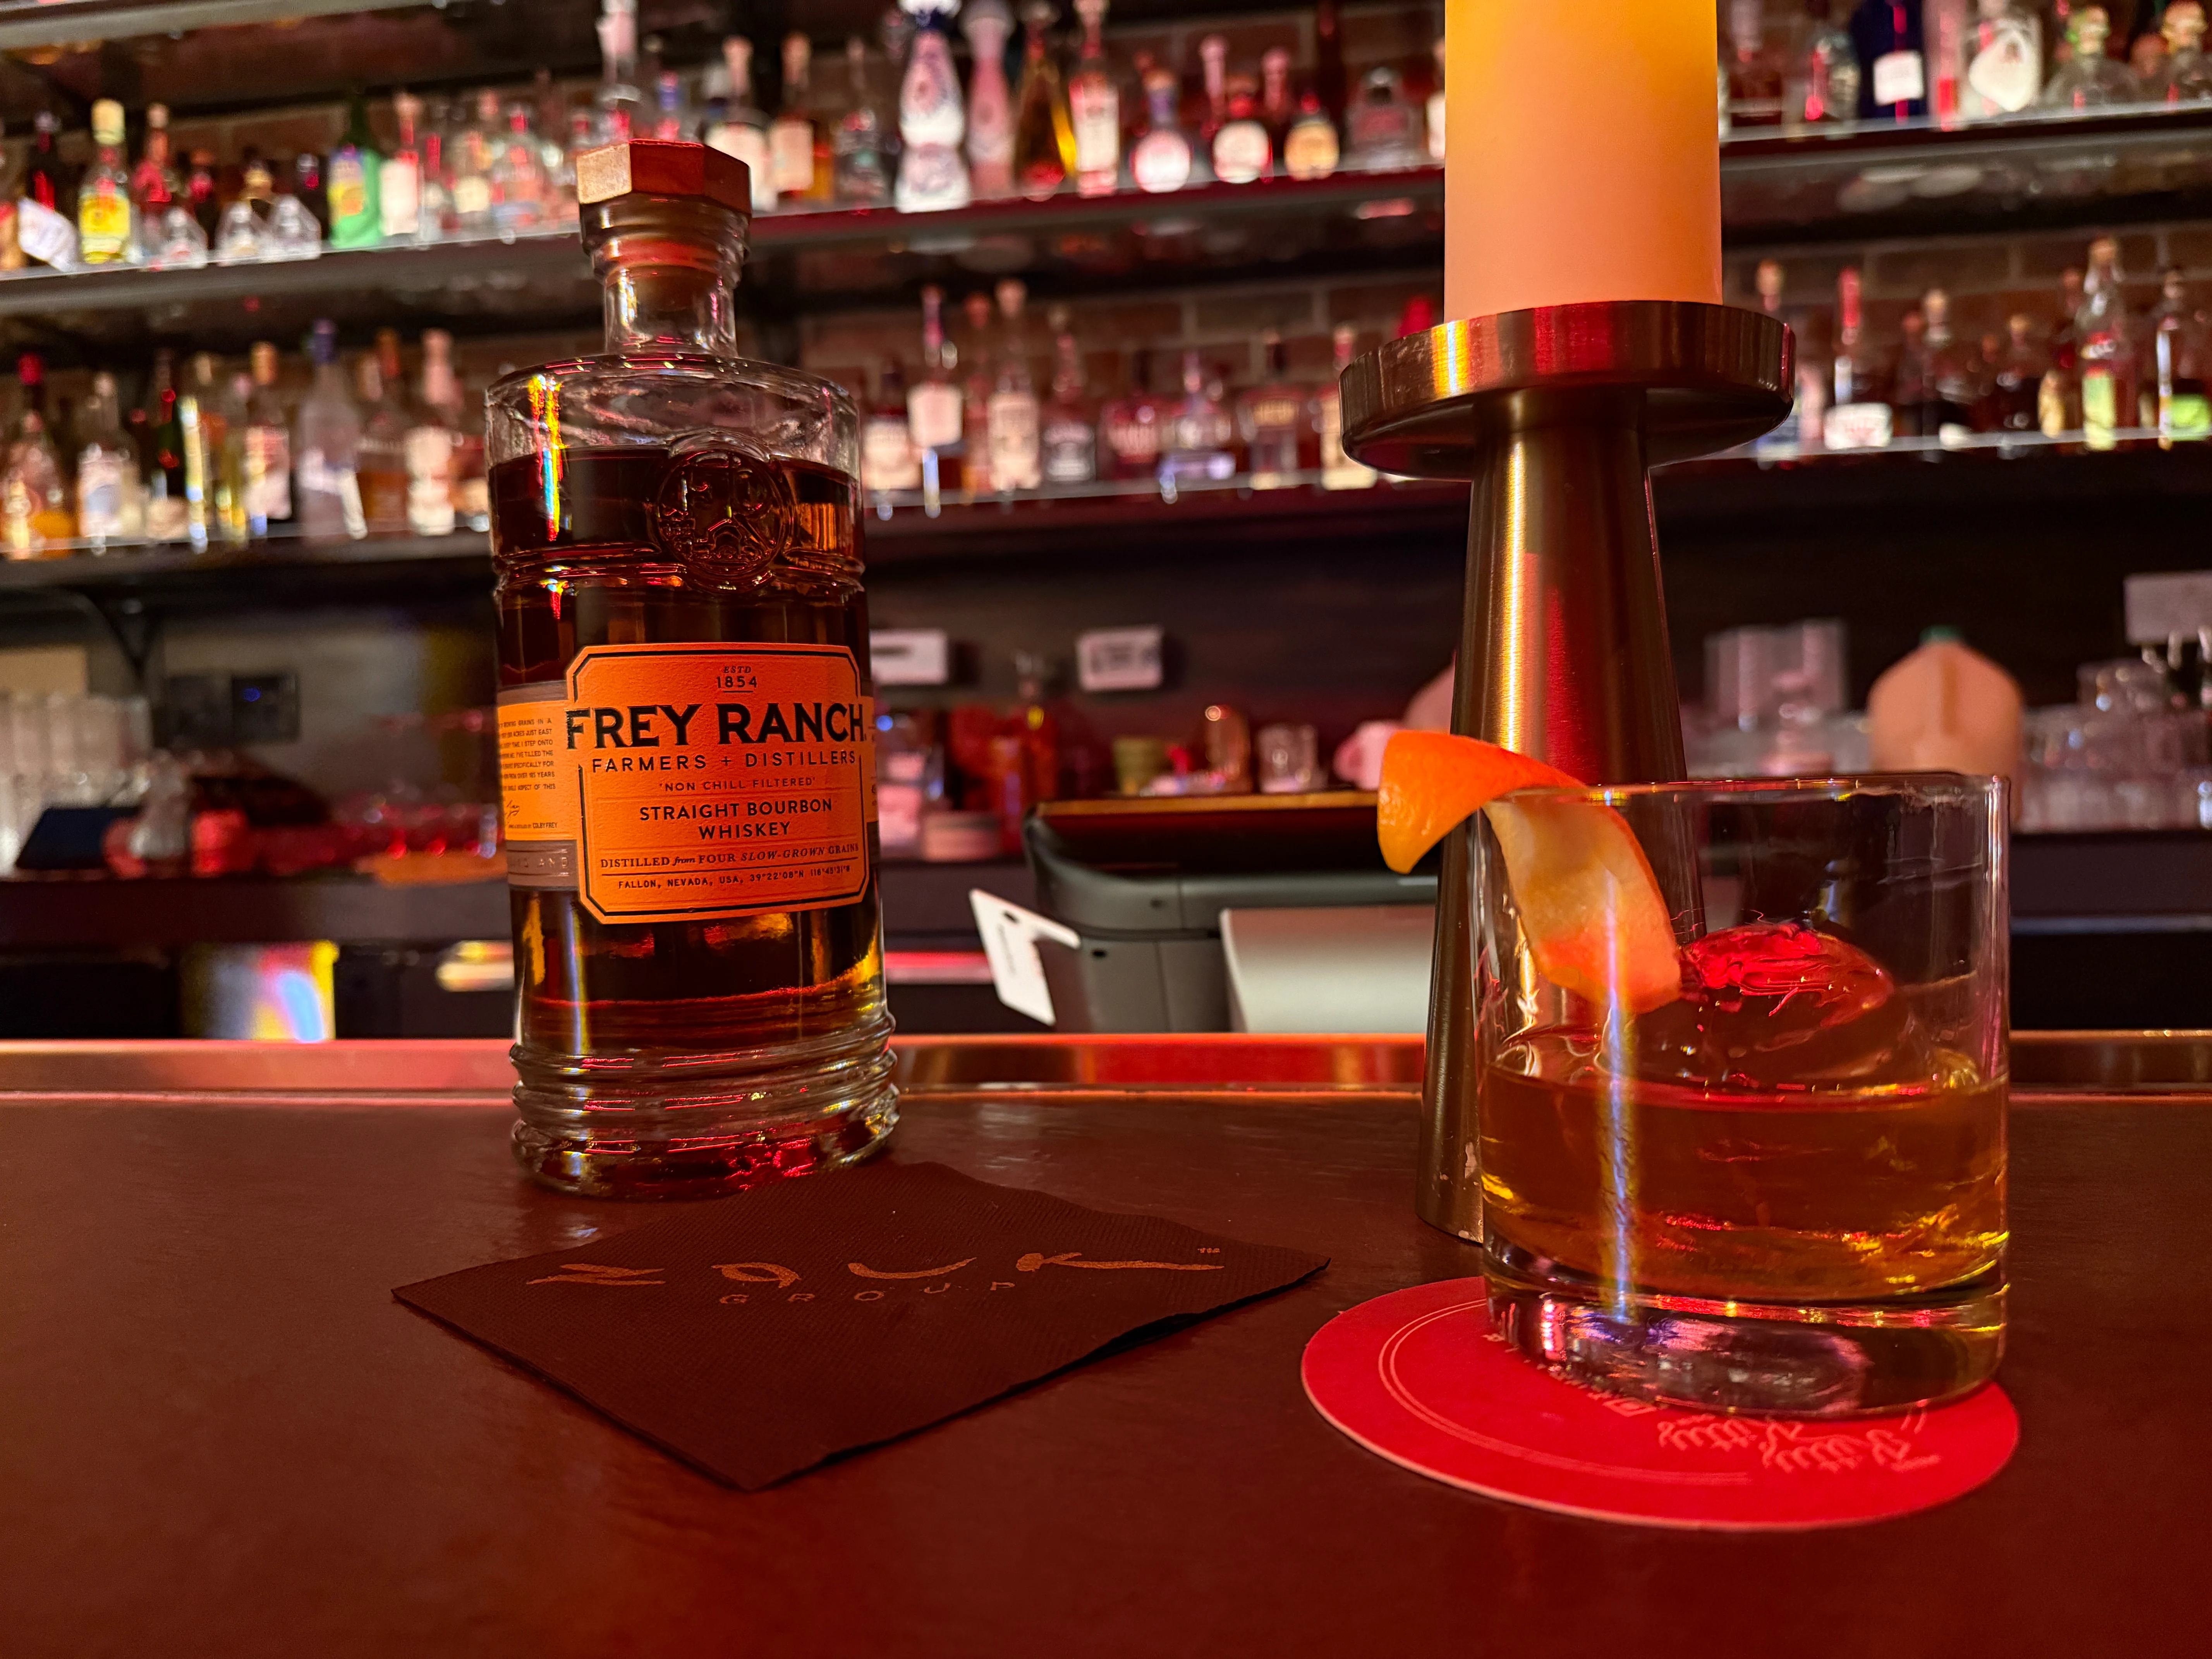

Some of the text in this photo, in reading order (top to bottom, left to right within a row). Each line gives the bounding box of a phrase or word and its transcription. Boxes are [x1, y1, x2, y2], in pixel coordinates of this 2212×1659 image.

[717, 676, 757, 689] 1854
[565, 702, 864, 749] FREY RANCH
[592, 754, 706, 773] FARMERS
[746, 750, 855, 767] DISTILLERS
[703, 780, 746, 790] CHILL
[640, 798, 832, 821] STRAIGHT BOURBON
[698, 821, 791, 840] WHISKEY
[601, 843, 859, 868] DISTILLED from FOUR SLOW-GROWN GRAINS
[618, 880, 661, 889] FALLON,
[667, 878, 713, 887] NEVADA,
[719, 875, 744, 884] USA,
[719, 1281, 1015, 1304] GROUP
